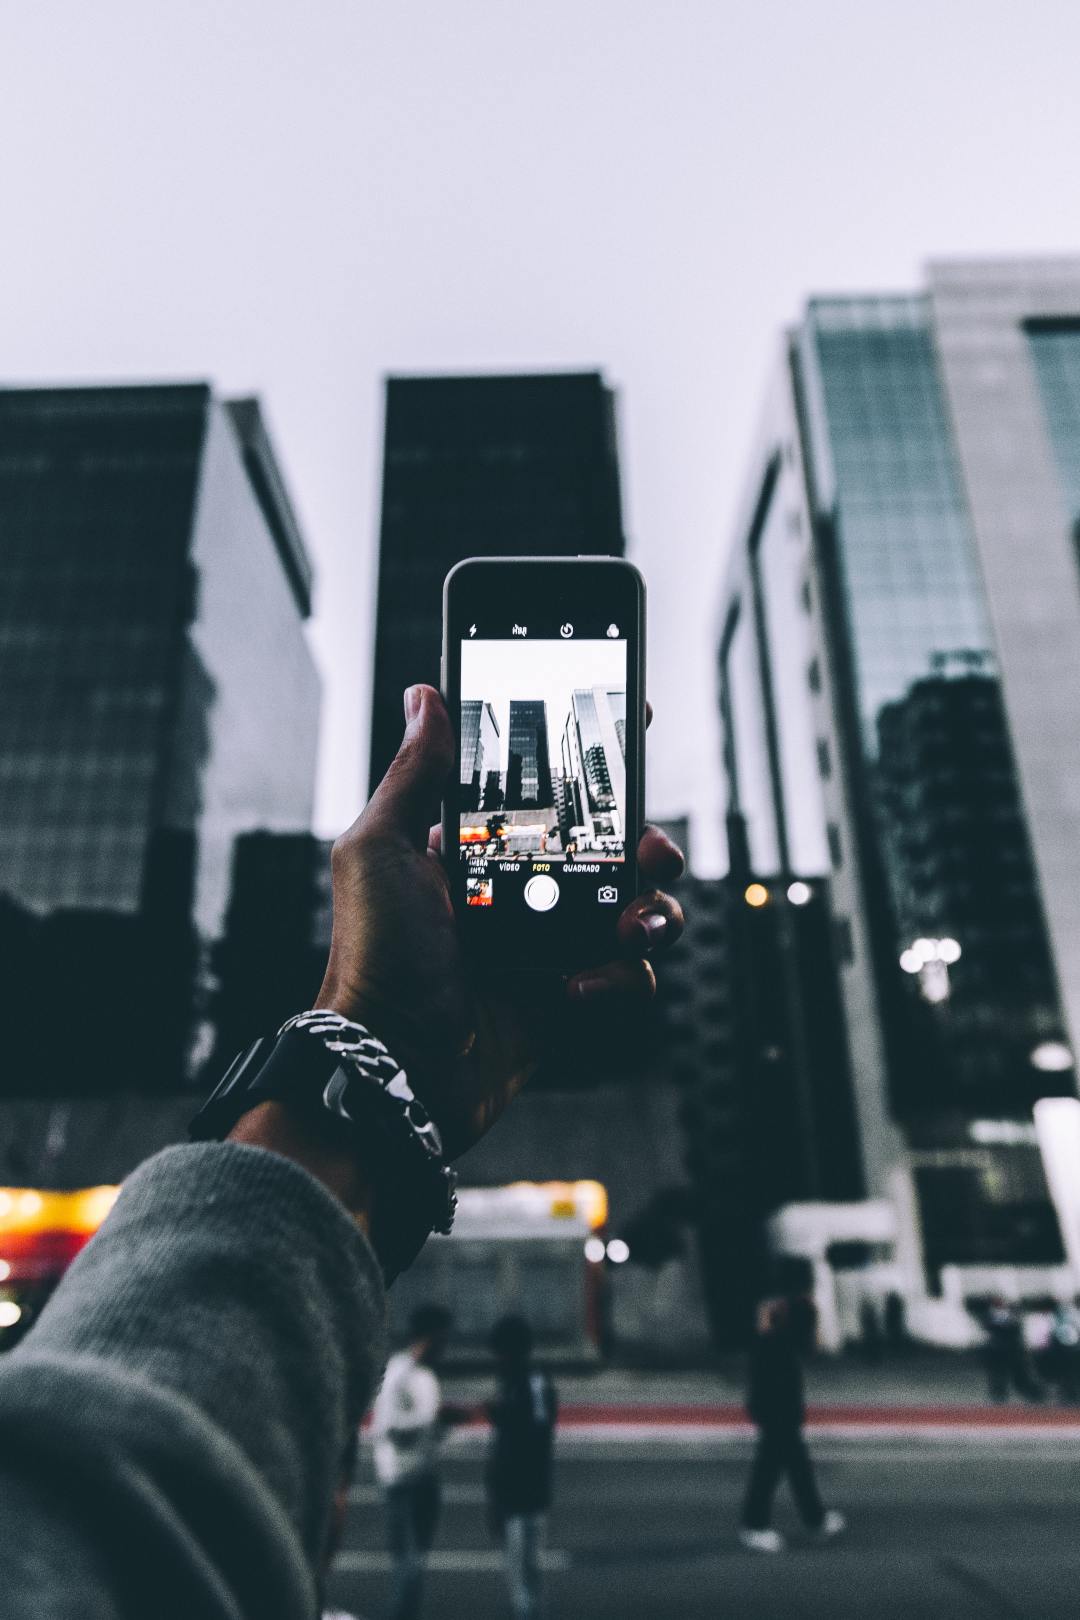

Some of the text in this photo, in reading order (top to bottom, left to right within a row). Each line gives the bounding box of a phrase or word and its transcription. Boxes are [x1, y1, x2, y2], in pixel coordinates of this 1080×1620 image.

[499, 862, 520, 872] VÍDEO
[532, 863, 550, 872] FOTO
[563, 863, 600, 873] QUADRADO
